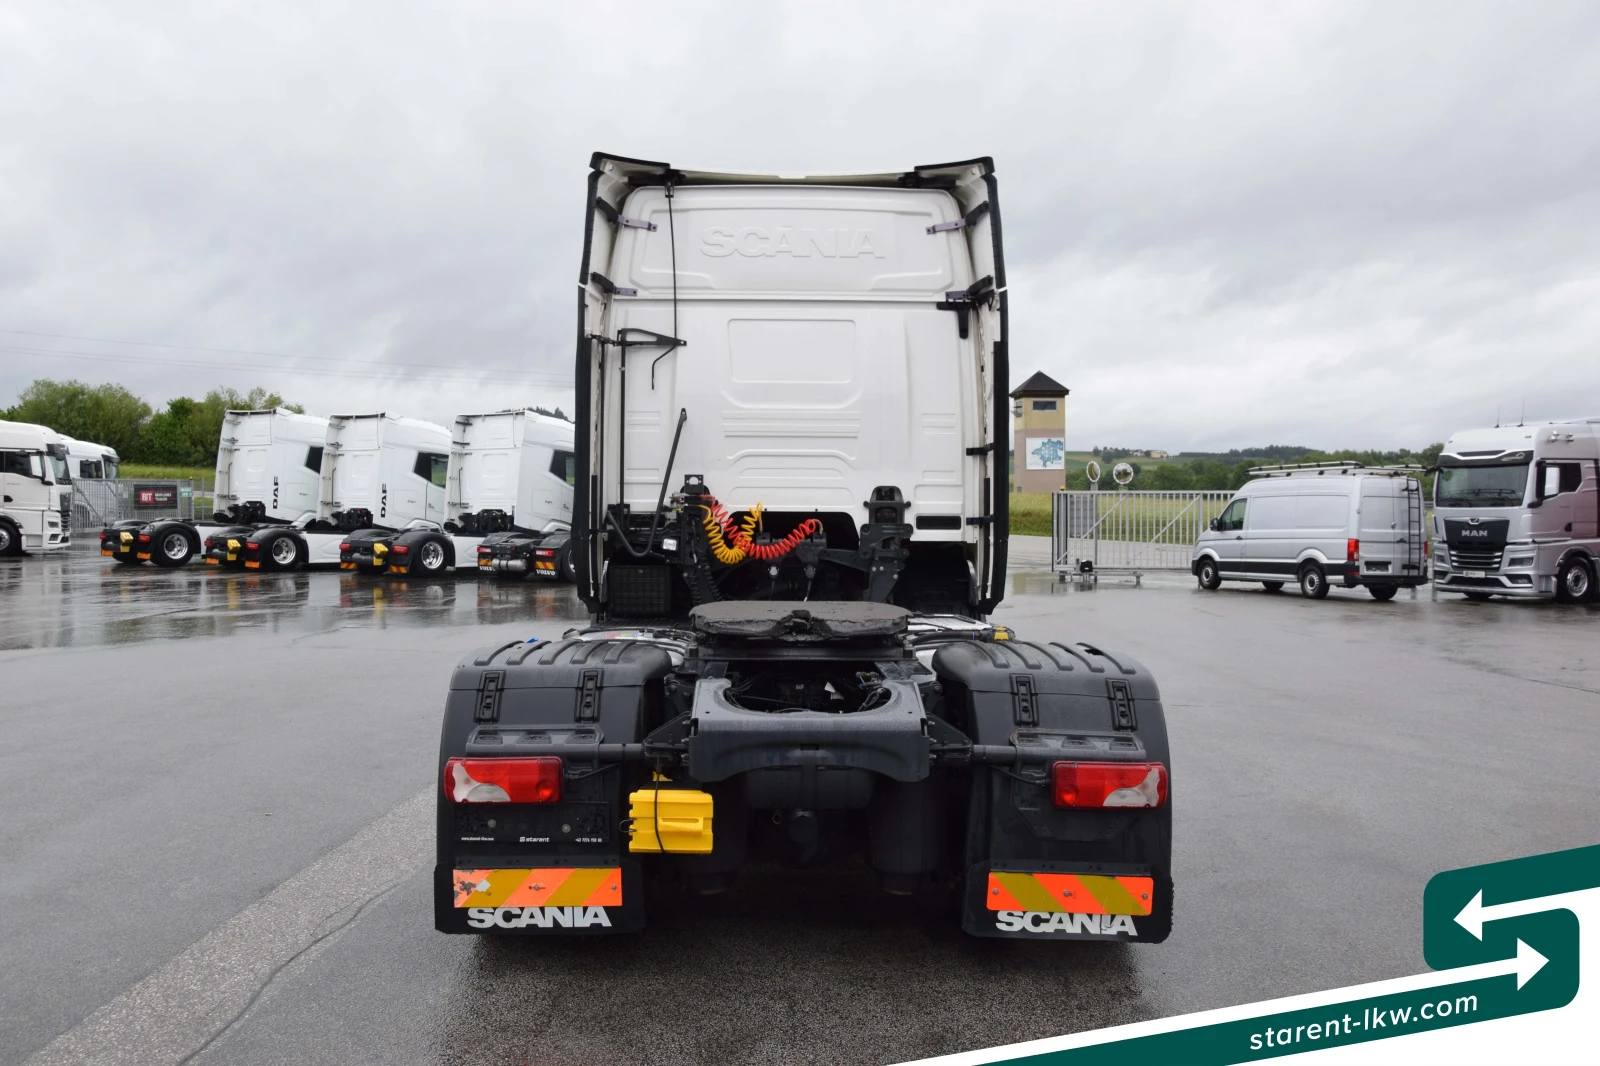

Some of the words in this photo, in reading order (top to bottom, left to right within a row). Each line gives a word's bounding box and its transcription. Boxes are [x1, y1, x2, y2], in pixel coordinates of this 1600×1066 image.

[700, 226, 886, 258] SCANIA
[380, 483, 388, 518] DAF
[1461, 529, 1488, 537] MAN
[536, 568, 556, 576] VOLVO
[467, 906, 613, 929] SCANIA
[995, 910, 1139, 936] SCANIA
